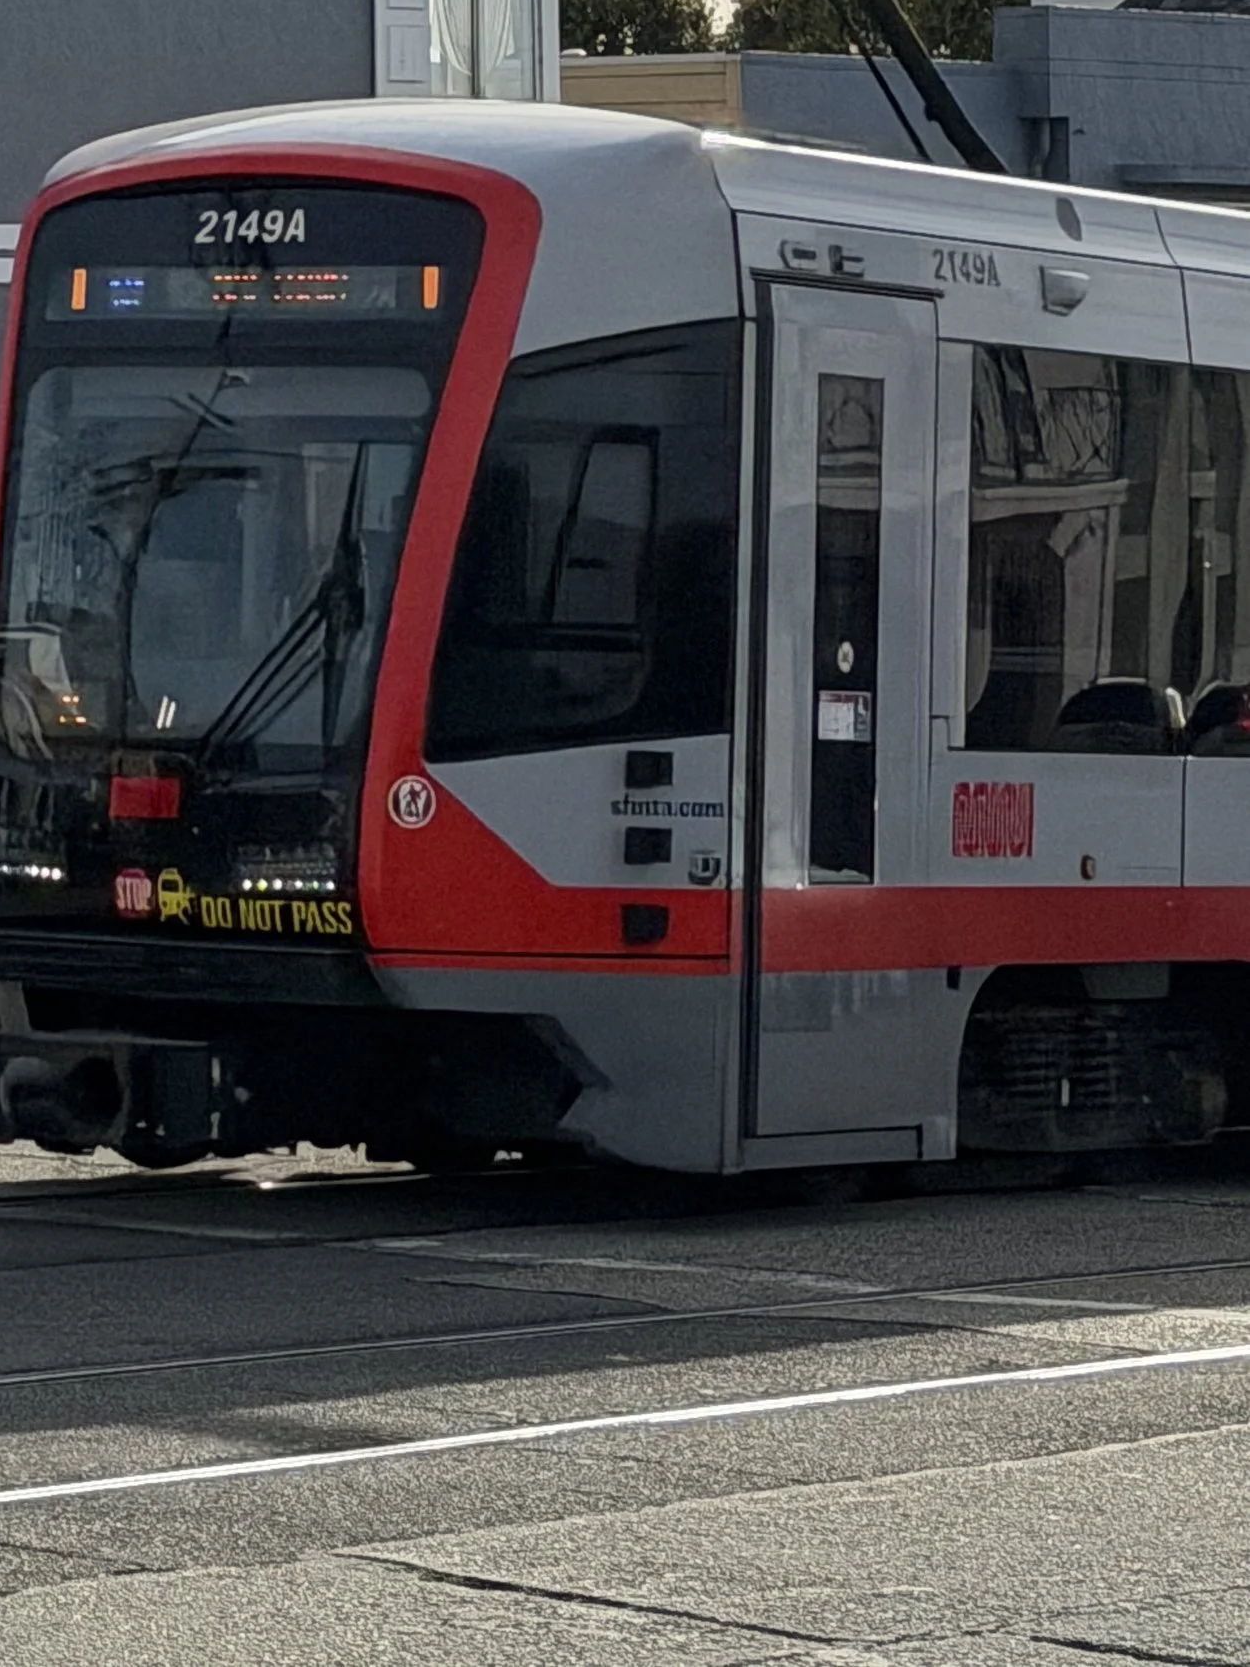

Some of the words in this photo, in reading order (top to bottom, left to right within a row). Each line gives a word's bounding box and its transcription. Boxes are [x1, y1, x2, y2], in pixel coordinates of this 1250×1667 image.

[194, 209, 306, 244] 2149A
[931, 248, 1001, 288] 2149A
[115, 875, 152, 911] STOP
[201, 897, 233, 928] DO
[240, 898, 283, 932] NOT
[292, 900, 351, 934] PASS
